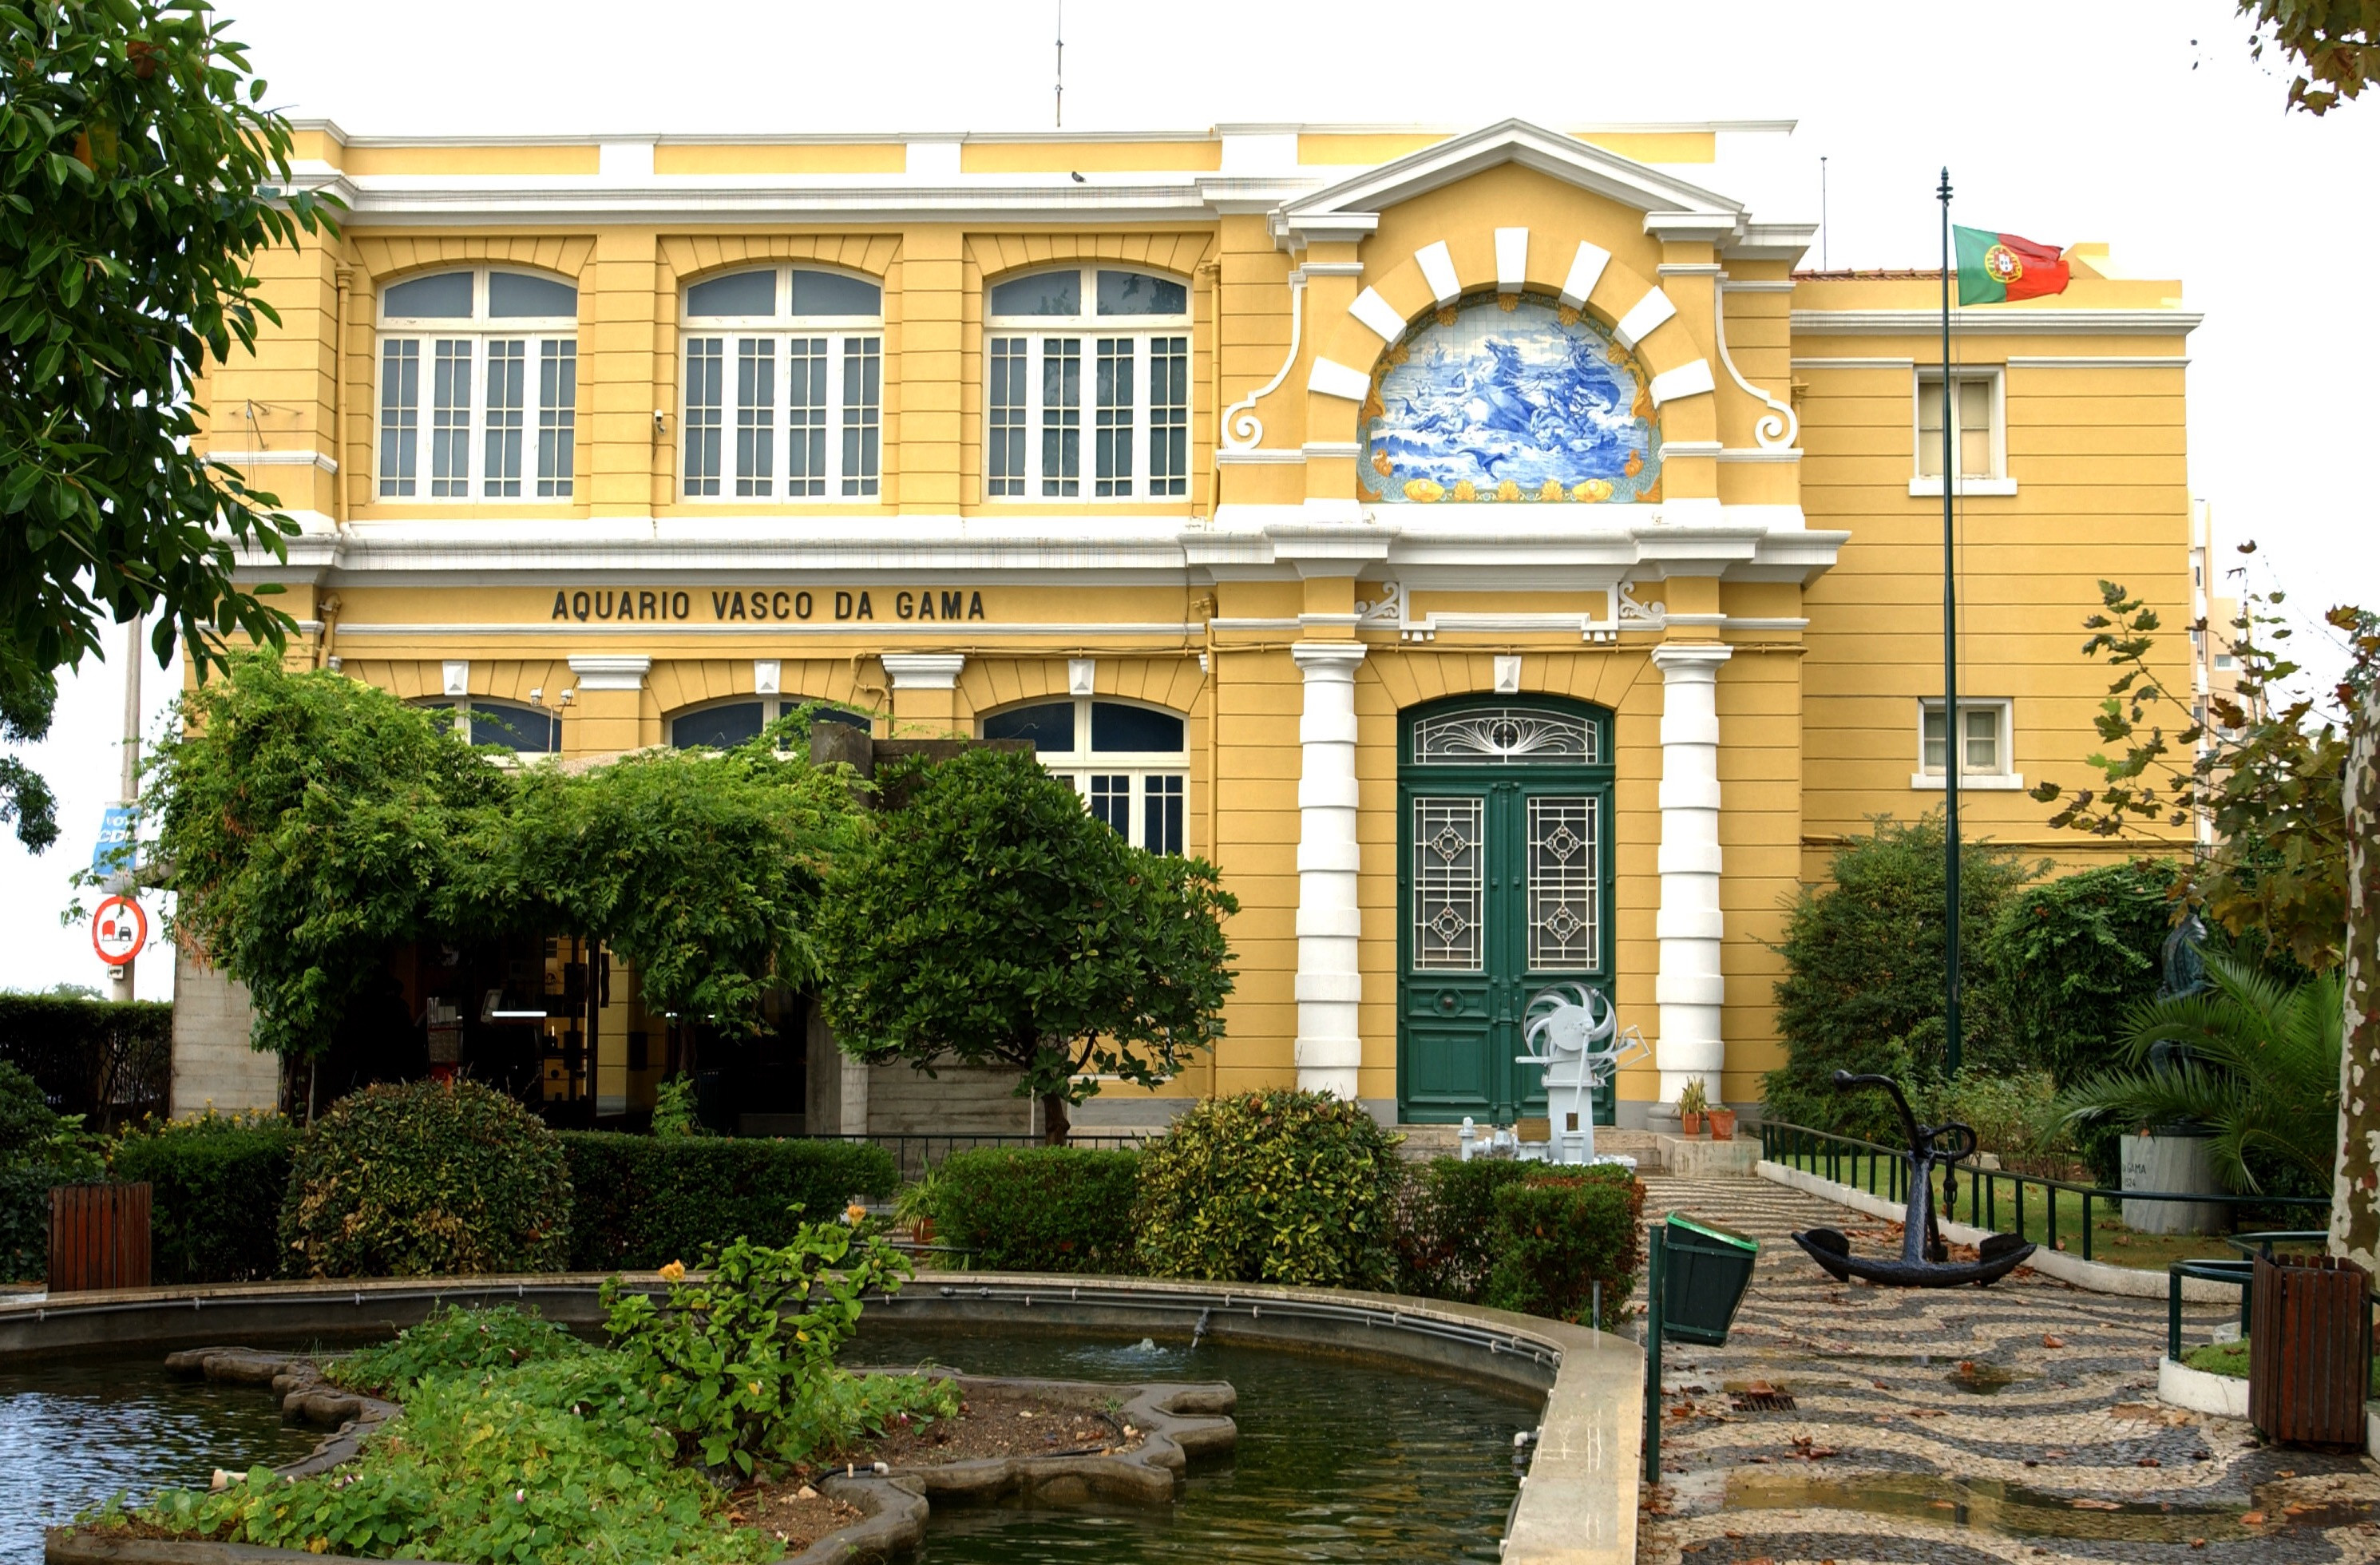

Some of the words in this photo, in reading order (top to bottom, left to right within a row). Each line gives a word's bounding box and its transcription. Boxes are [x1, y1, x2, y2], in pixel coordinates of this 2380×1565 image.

[552, 590, 691, 621] AQUARIO
[711, 590, 814, 620] VASCO
[835, 590, 873, 620] DA
[896, 590, 985, 620] GAMA
